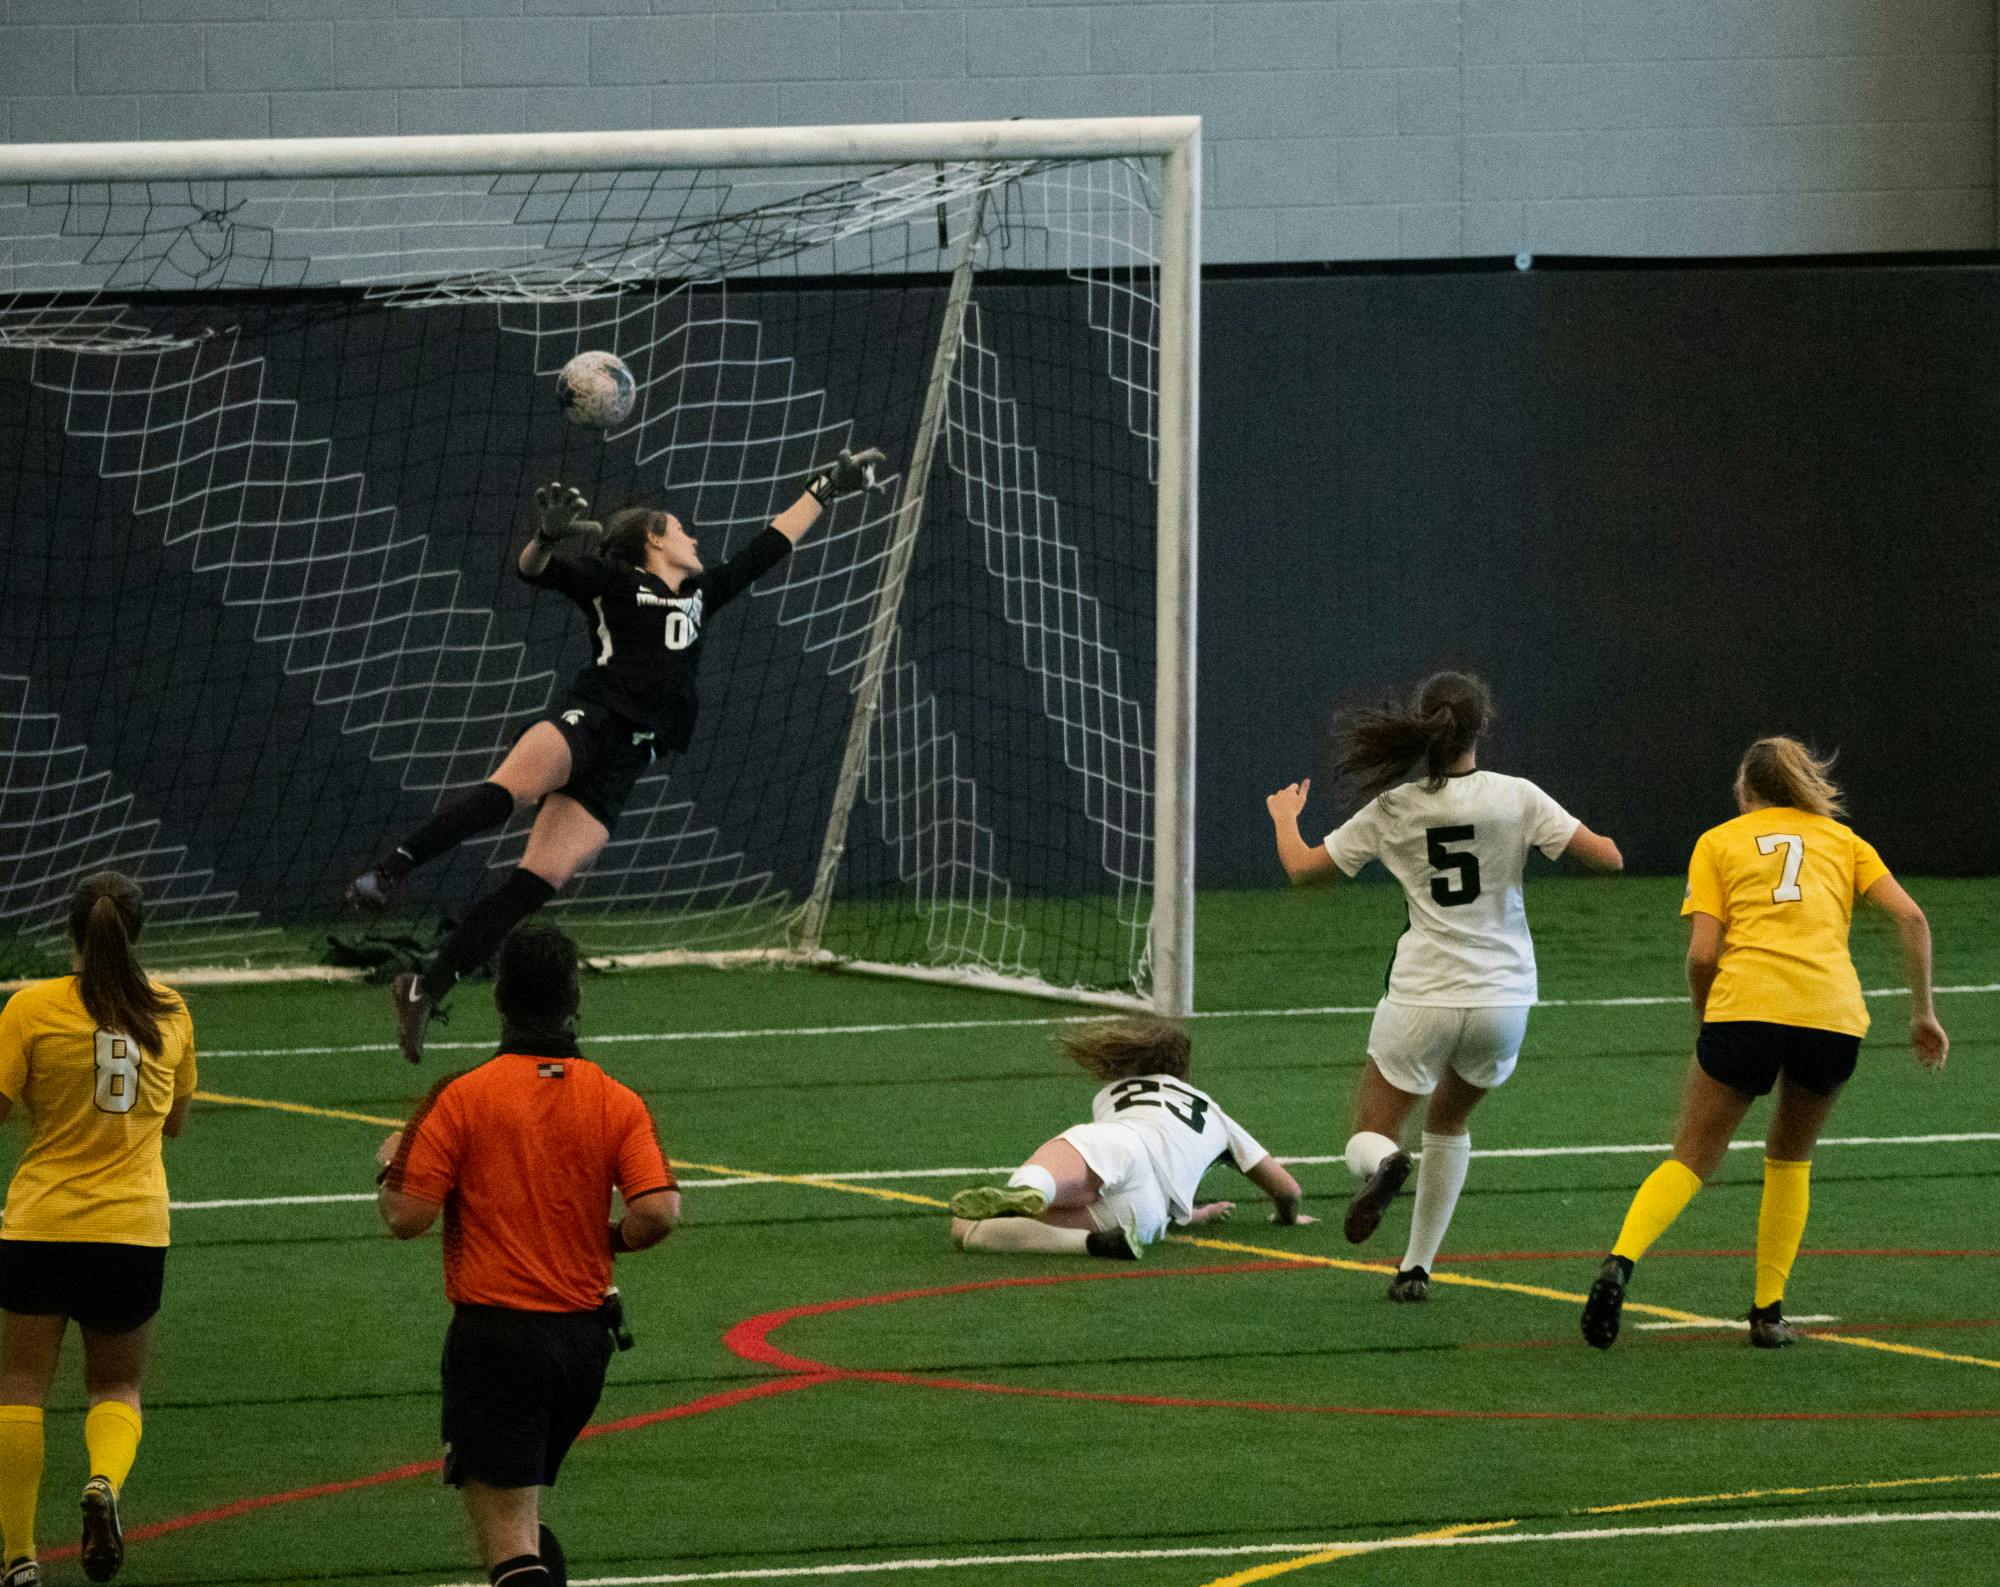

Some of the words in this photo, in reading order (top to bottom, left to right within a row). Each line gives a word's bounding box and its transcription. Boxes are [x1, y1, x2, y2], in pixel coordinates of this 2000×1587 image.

[1426, 825, 1481, 907] 5
[1755, 833, 1804, 904] 7
[93, 1028, 142, 1113] 8
[1110, 1080, 1208, 1134] 23
